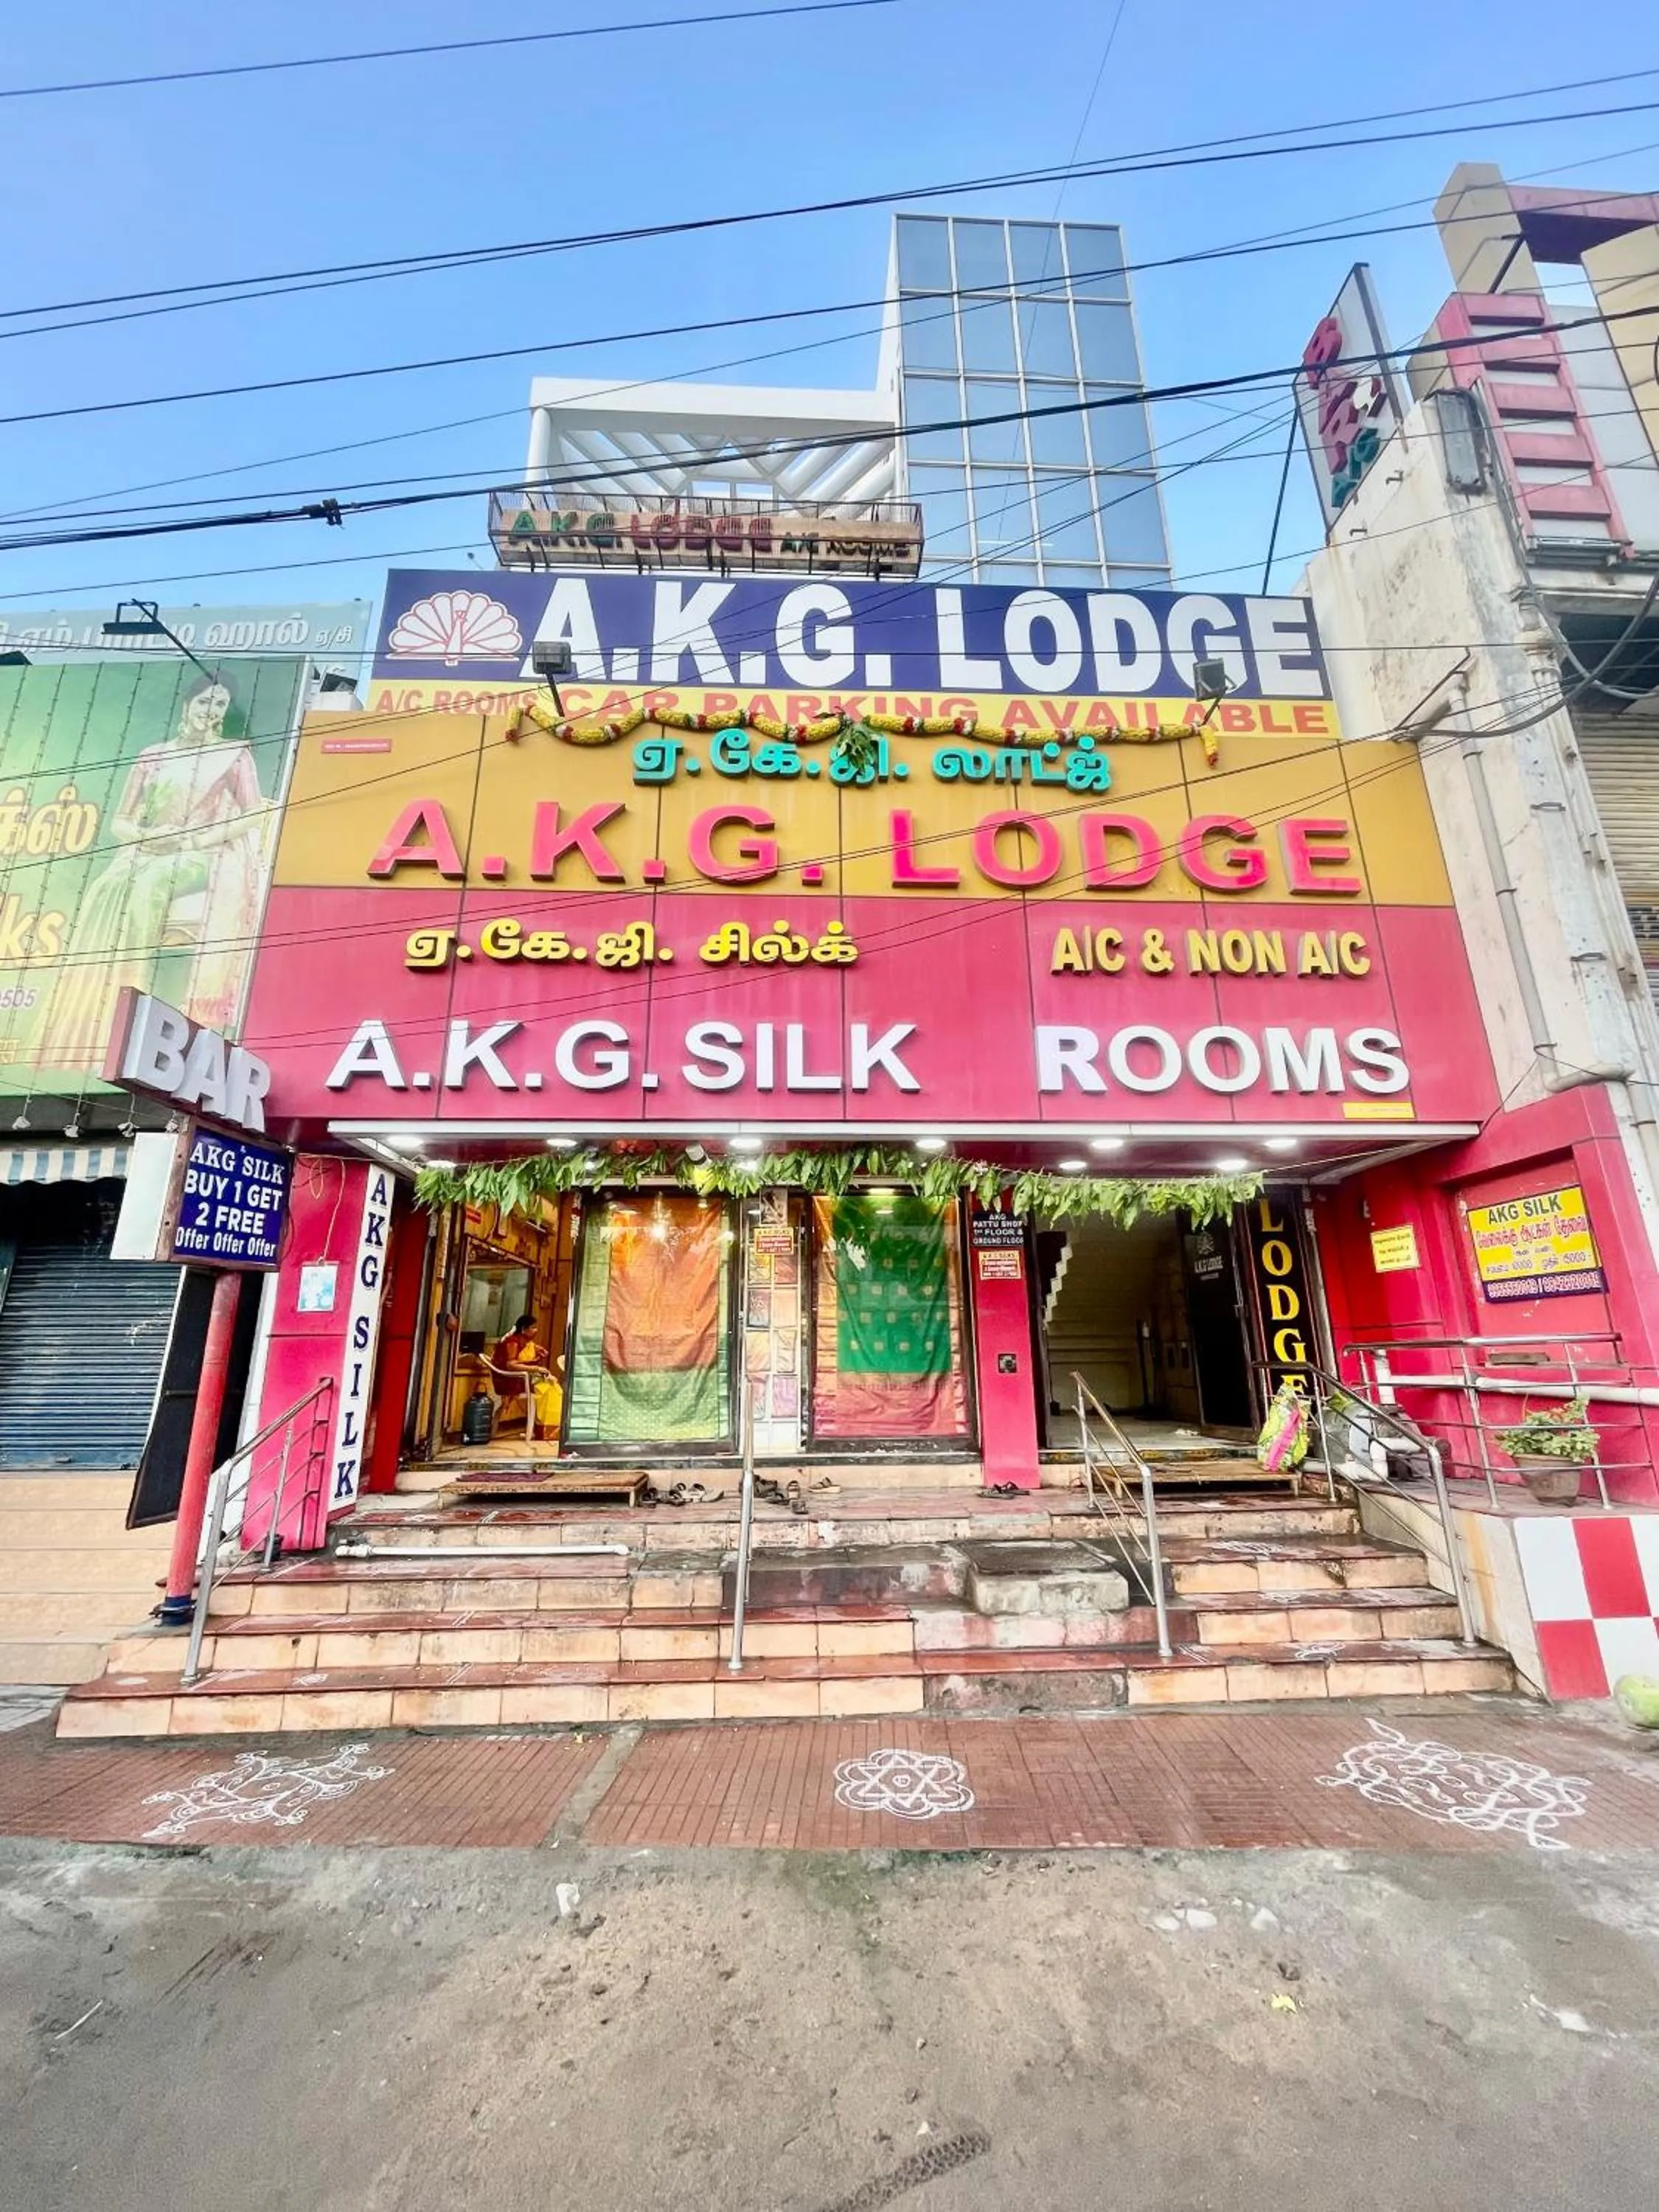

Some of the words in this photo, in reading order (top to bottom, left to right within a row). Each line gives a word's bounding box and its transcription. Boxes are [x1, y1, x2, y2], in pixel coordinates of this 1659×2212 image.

[935, 588, 1324, 697] LODGE
[375, 689, 424, 714] A/C
[434, 692, 538, 717] ROOMS
[560, 689, 679, 722] CAR
[703, 692, 979, 725] PARKING
[933, 735, 1112, 792] லாட்ஜ்
[366, 799, 824, 884] A.K.G.
[889, 808, 1361, 896] LODGE
[699, 919, 860, 967] சில்க்
[1140, 928, 1175, 976] &
[1186, 929, 1287, 978] NON
[122, 994, 271, 1134] BAR
[681, 1021, 923, 1093] SILK
[1037, 1024, 1411, 1096] ROOMS
[189, 1141, 236, 1172] AKG
[241, 1155, 285, 1185] SILK
[184, 1169, 229, 1200] BUY
[233, 1180, 243, 1204] 1
[246, 1183, 283, 1211] GET
[1488, 1204, 1519, 1225] AKG
[1523, 1194, 1562, 1217] SILK
[174, 1226, 210, 1250] Offer
[212, 1231, 245, 1254] Offer
[246, 1237, 276, 1258] Offer
[195, 1201, 210, 1227] 2
[215, 1205, 266, 1236] FREE
[360, 1172, 387, 1289] AKG
[984, 1228, 1015, 1236] FLOOR
[333, 1315, 370, 1500] SILK
